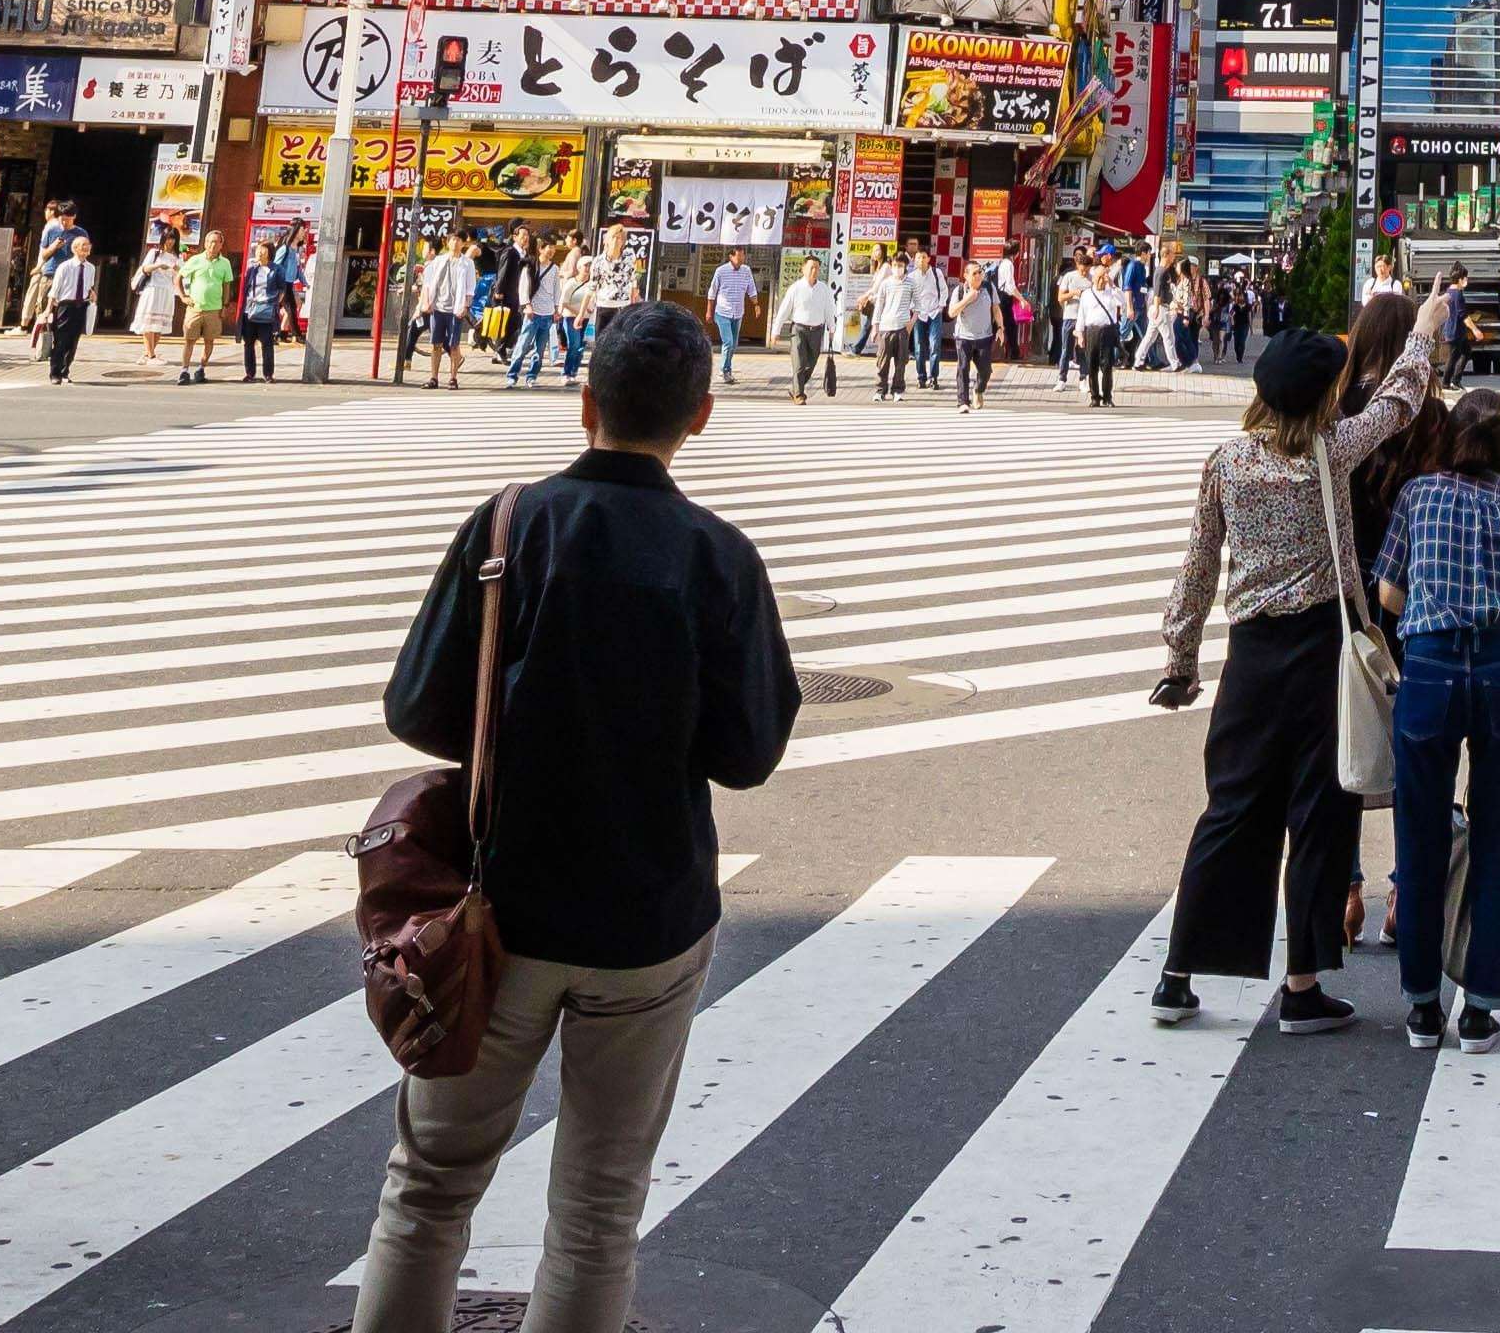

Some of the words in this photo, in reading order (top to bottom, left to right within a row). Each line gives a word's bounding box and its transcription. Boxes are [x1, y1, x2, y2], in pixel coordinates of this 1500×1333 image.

[1260, 2, 1294, 29] 7.1
[909, 32, 1013, 60] OKONOMI
[1019, 41, 1070, 64] YAKI
[520, 25, 827, 105] とらそば
[1253, 52, 1331, 75] MARUHAN
[459, 84, 501, 104] 280円
[110, 109, 167, 121] 24時間営業
[1358, 105, 1376, 181] ROAD
